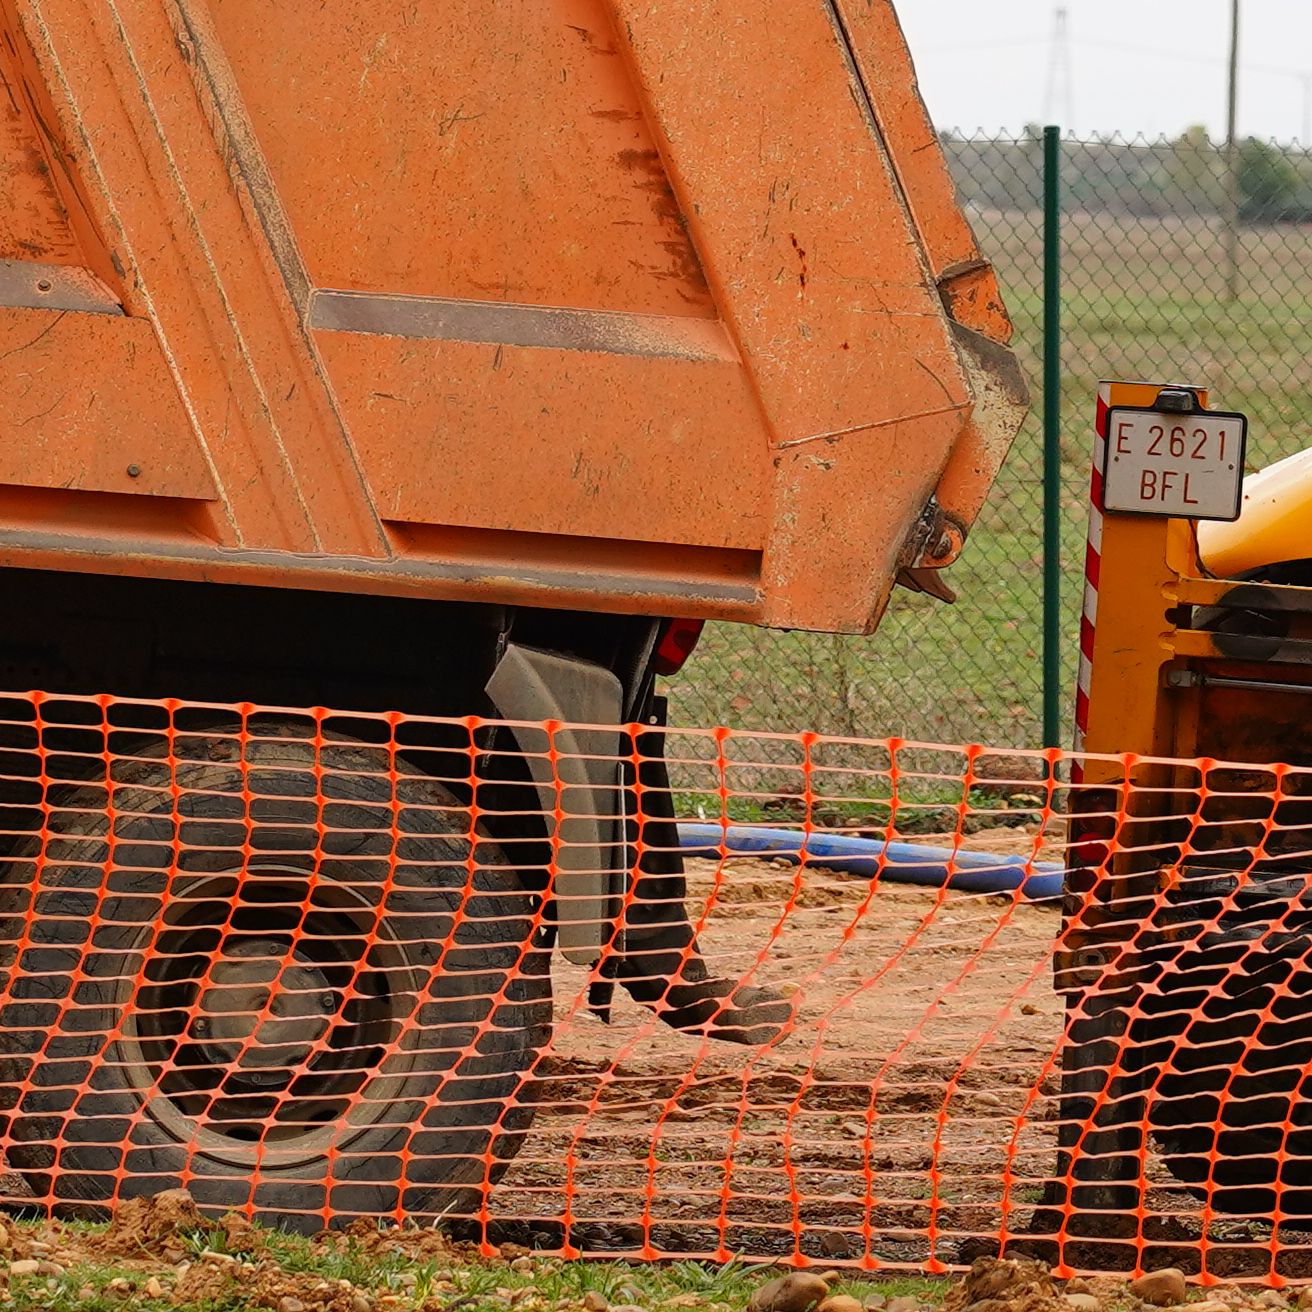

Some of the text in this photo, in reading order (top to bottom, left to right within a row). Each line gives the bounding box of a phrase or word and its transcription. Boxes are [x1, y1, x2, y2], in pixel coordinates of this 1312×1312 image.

[1117, 423, 1225, 461] E 2621
[1140, 470, 1198, 503] BFL
